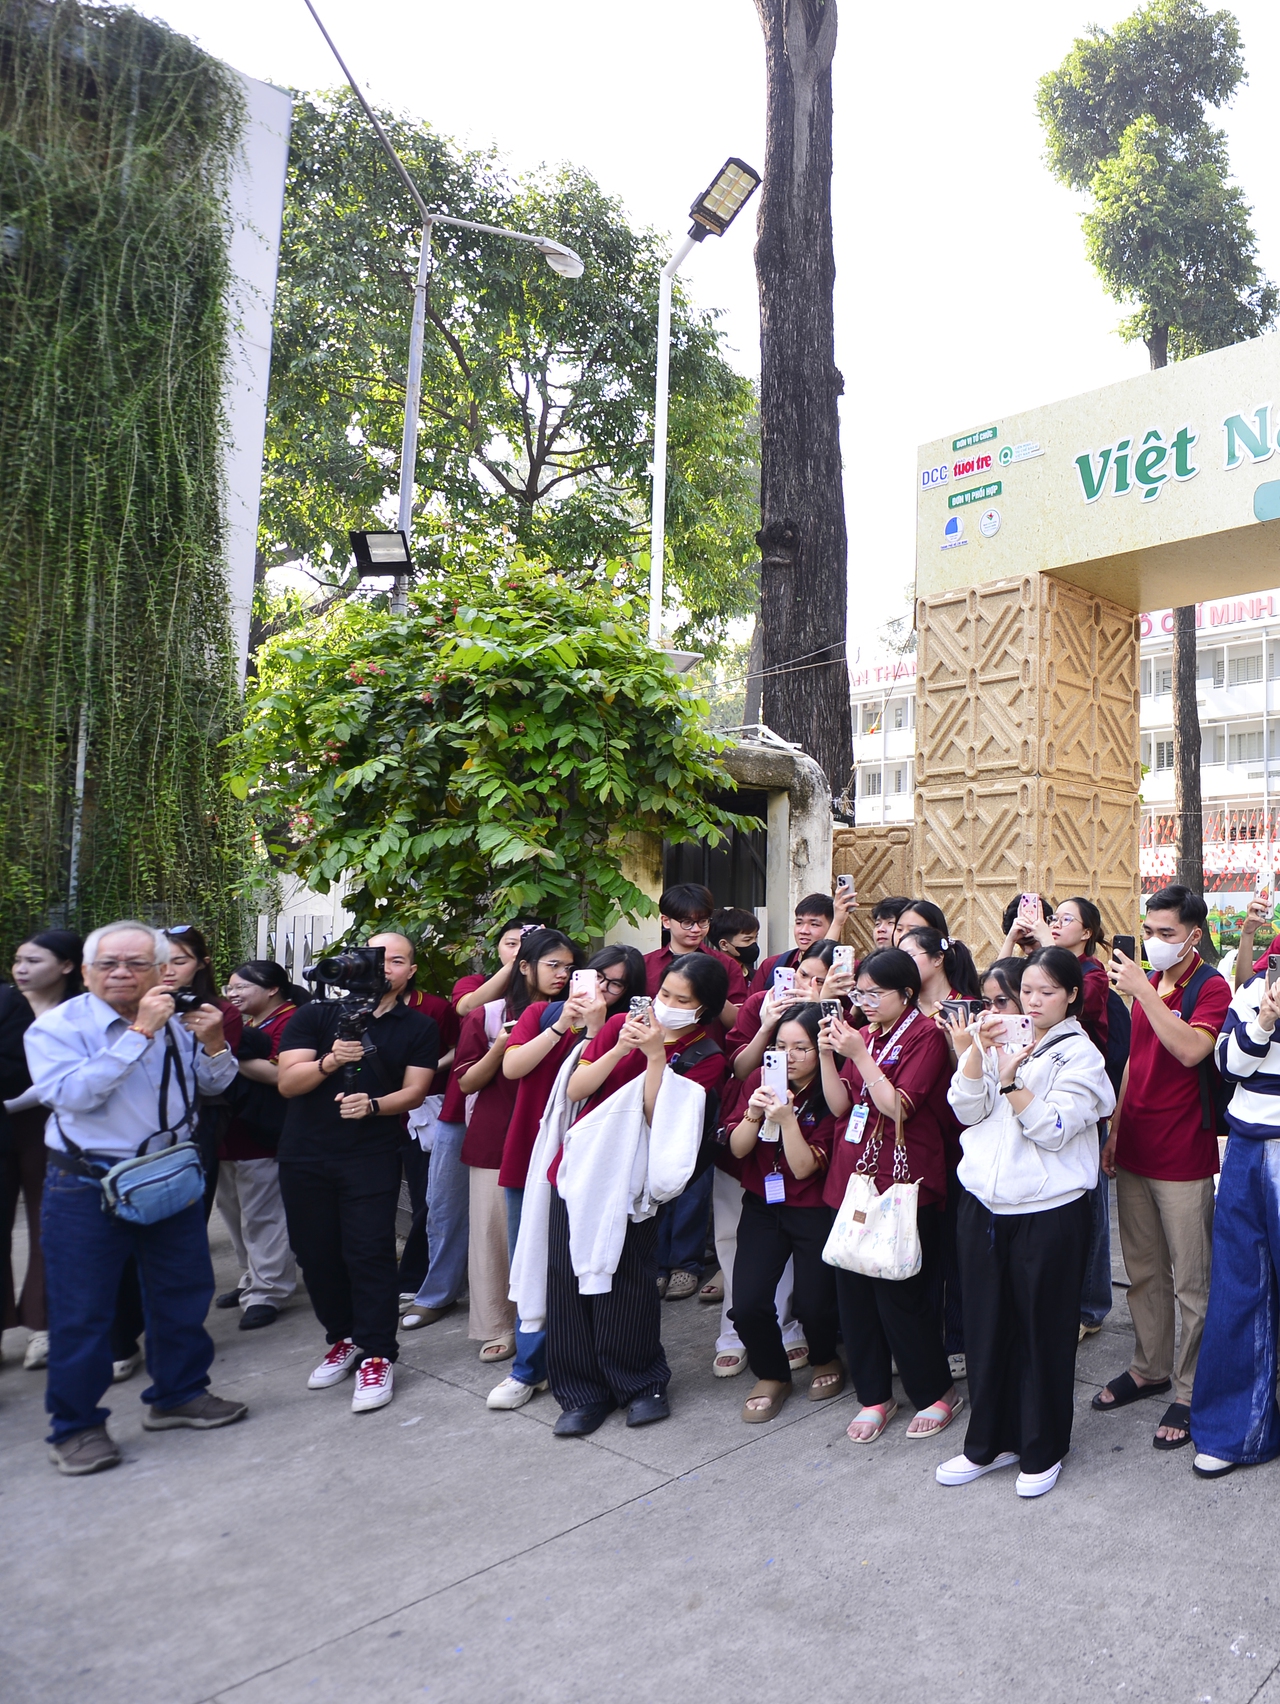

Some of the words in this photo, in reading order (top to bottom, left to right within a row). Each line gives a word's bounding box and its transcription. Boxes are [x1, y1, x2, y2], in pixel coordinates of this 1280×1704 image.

[922, 465, 948, 486] DCC
[1075, 426, 1197, 500] Việt
[1210, 595, 1274, 626] MINH
